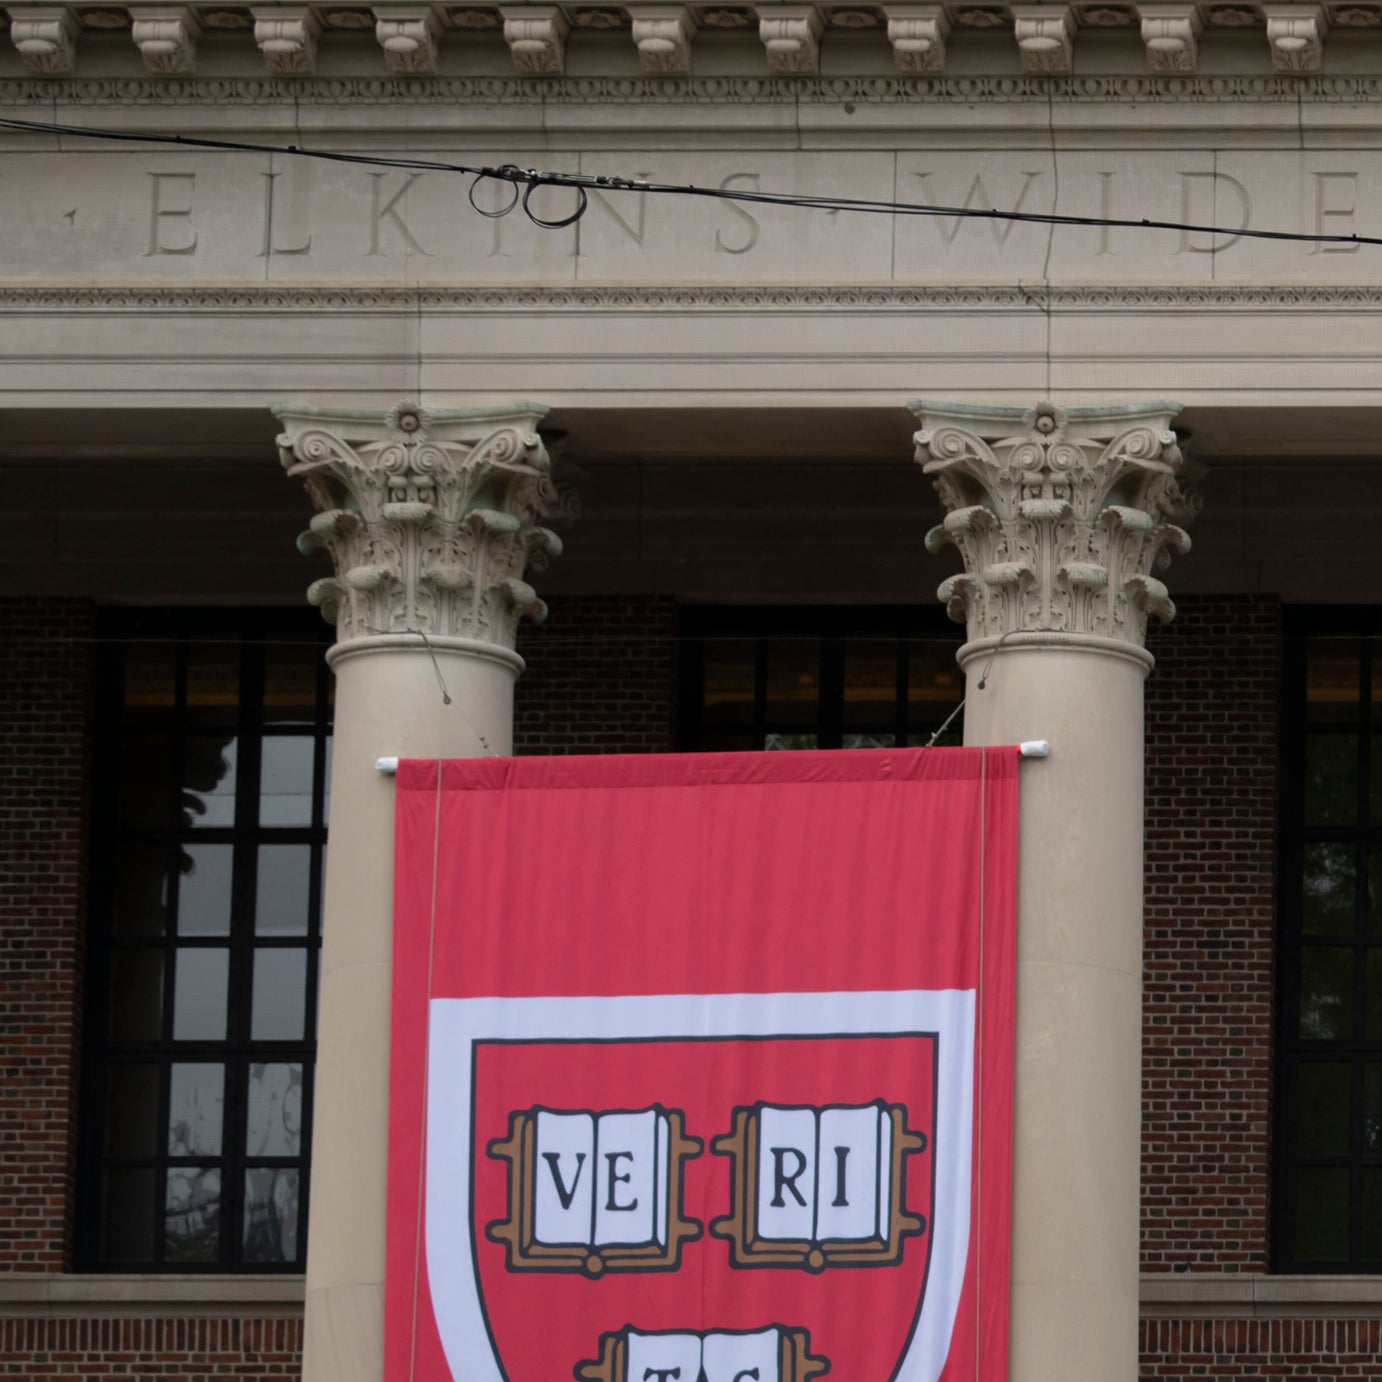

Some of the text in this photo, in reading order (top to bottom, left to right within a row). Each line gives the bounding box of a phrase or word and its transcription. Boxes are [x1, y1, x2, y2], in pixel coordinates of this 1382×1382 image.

[143, 170, 762, 257] ELKINS
[541, 1145, 851, 1212] VE RI
